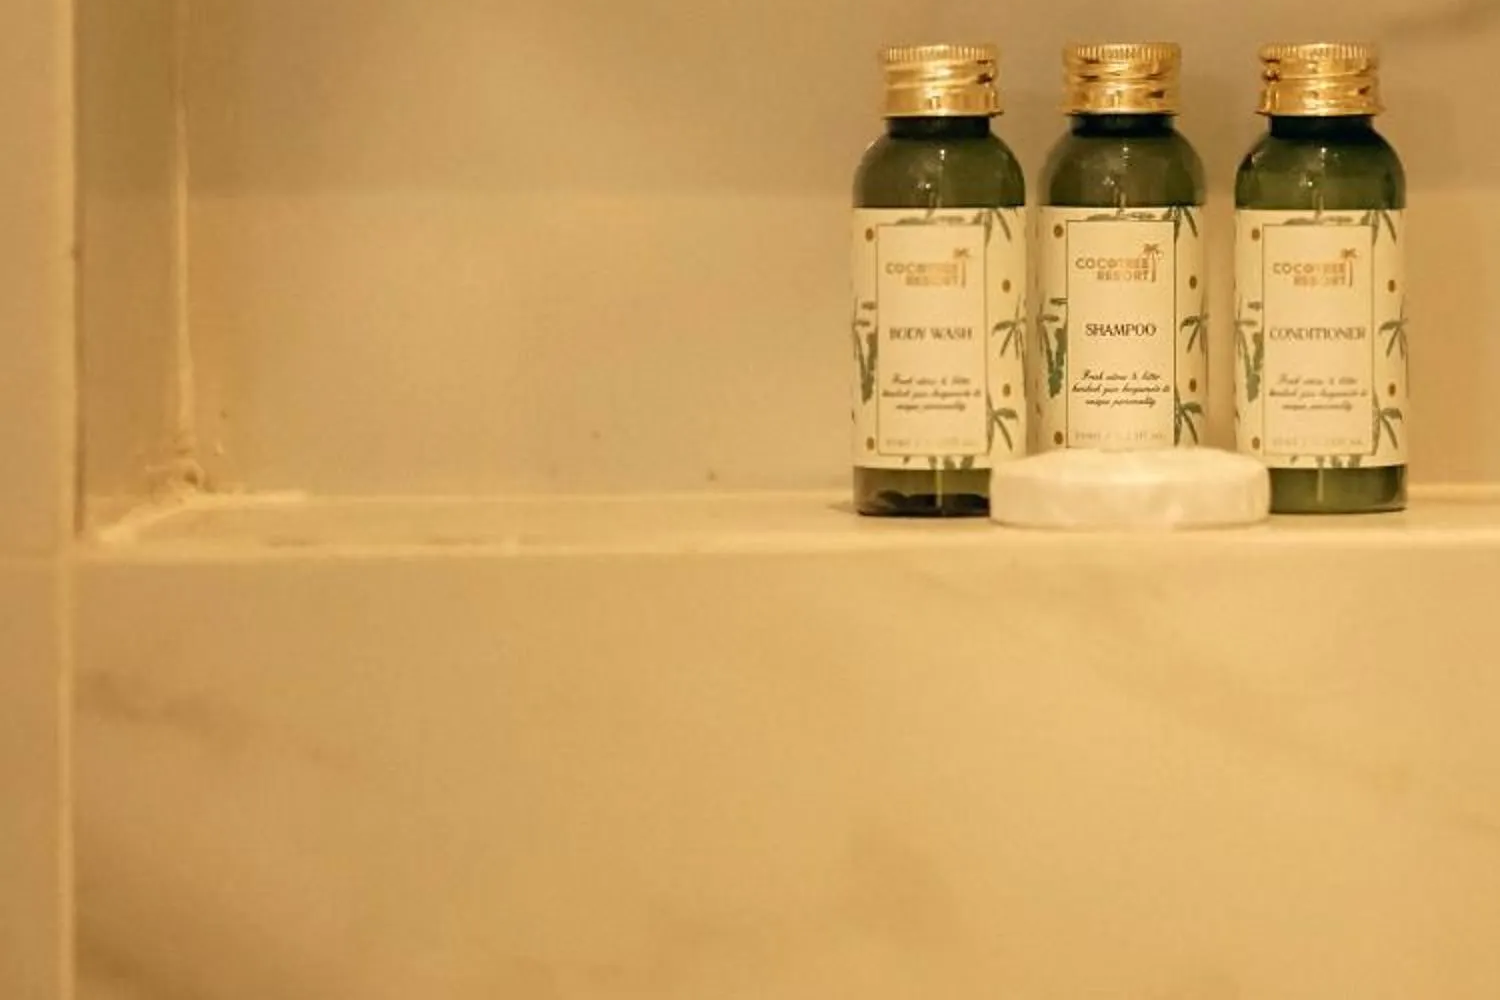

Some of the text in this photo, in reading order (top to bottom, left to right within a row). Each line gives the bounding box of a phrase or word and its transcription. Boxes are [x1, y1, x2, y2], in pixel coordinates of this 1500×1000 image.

[888, 326, 973, 340] BODY WASH
[1085, 323, 1157, 336] SHAMPOO
[1269, 326, 1366, 340] CONDITIONER
